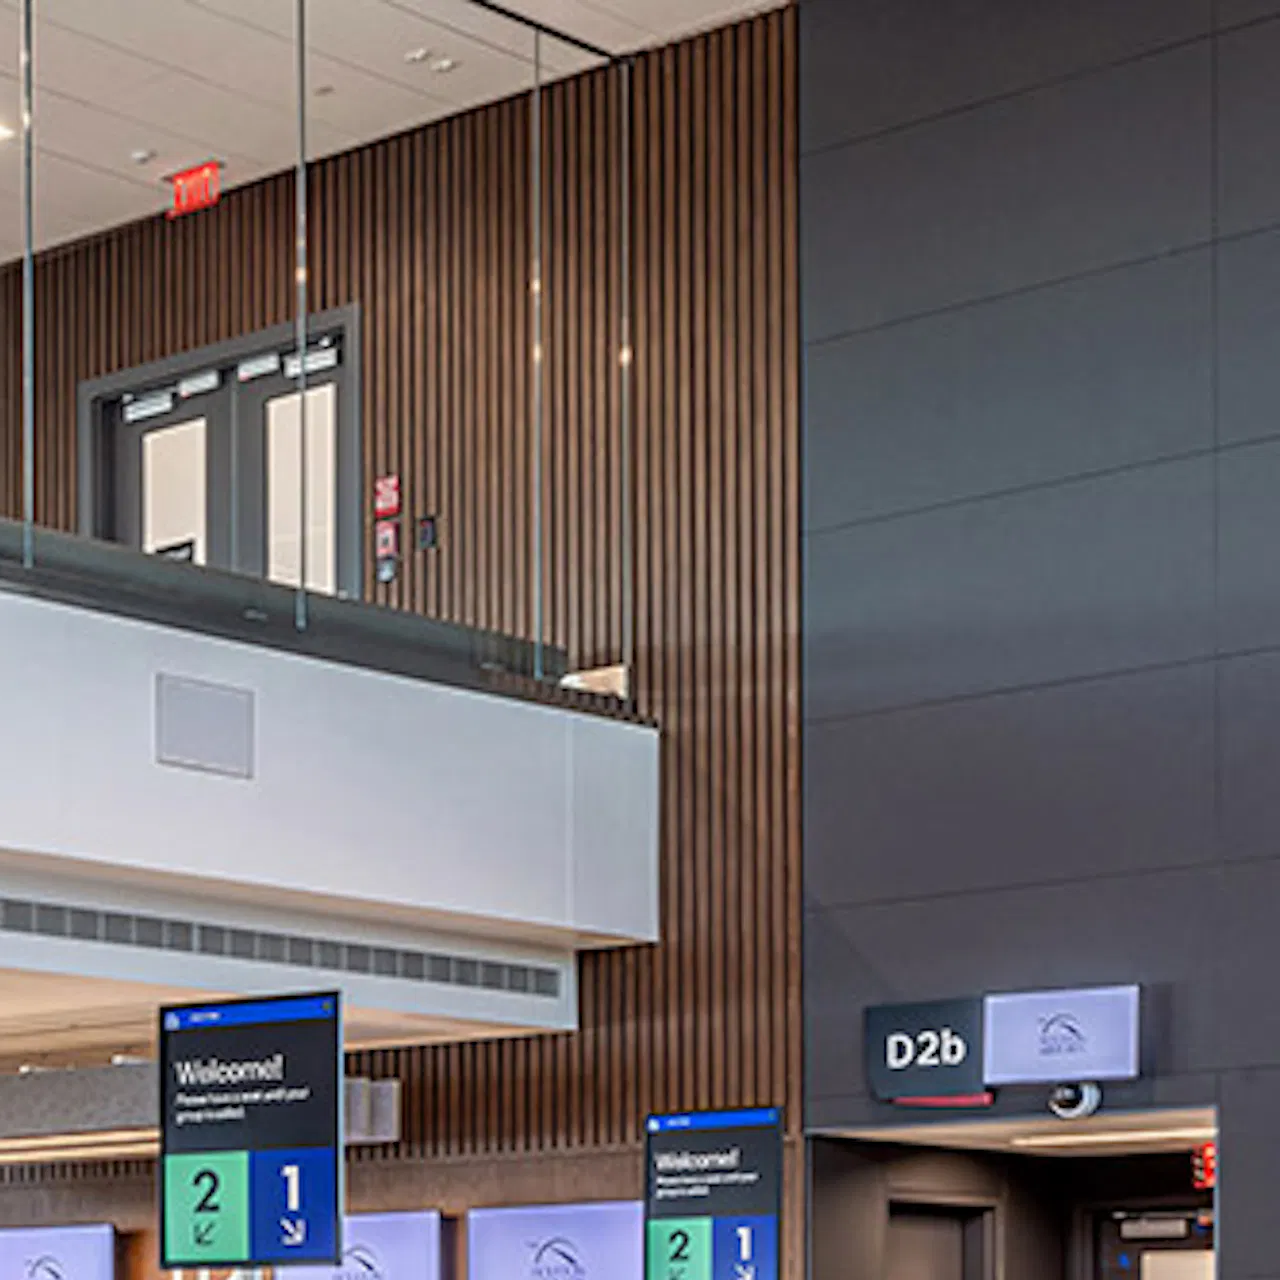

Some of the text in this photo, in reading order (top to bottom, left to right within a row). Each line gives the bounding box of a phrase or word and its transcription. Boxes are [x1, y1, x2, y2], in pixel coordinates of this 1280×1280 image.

[886, 1027, 966, 1070] D2b
[175, 1054, 284, 1086] Welcome!
[192, 1169, 220, 1213] 2
[281, 1165, 300, 1211] 1
[668, 1229, 689, 1262] 2
[736, 1226, 753, 1261] 1
